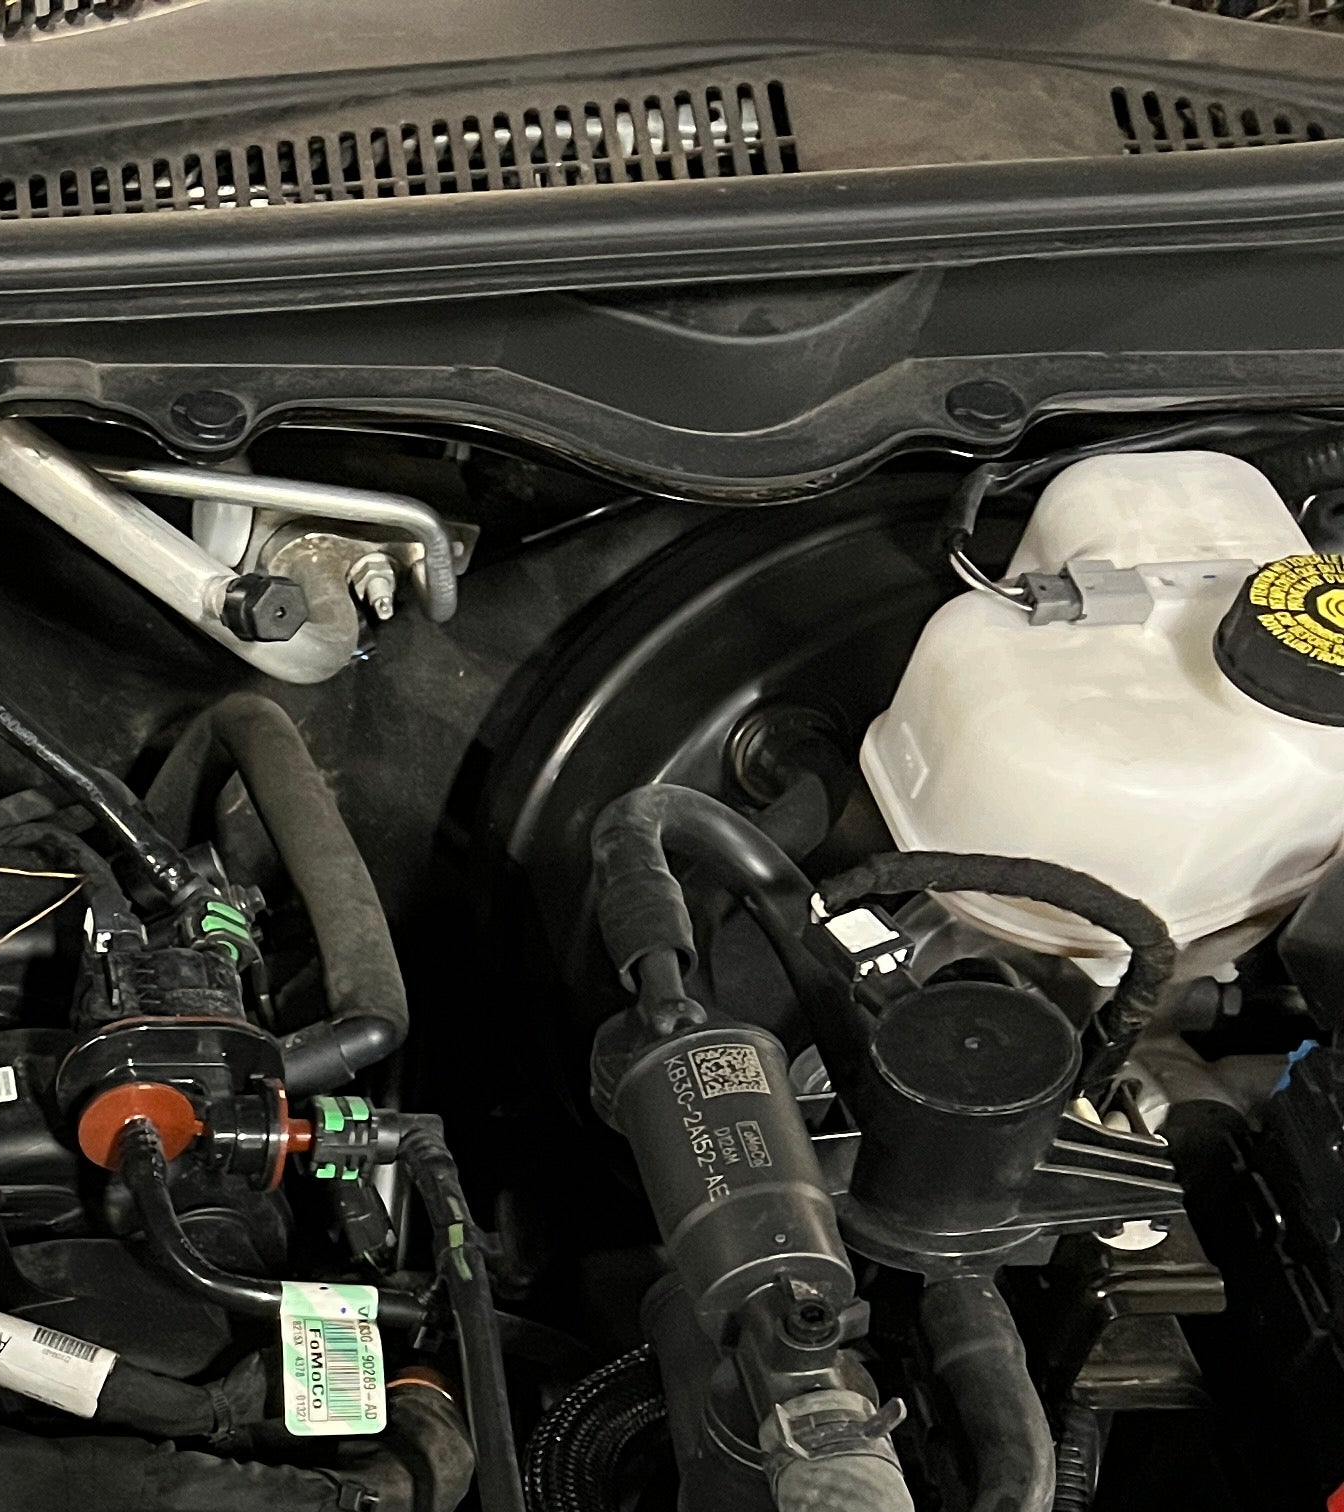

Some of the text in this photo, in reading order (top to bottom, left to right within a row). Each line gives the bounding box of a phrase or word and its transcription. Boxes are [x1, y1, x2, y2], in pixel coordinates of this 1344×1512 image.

[1277, 632, 1312, 654] FLUID
[663, 1055, 731, 1203] KB3C-2A152-AE
[308, 1328, 325, 1410] FoMoCo
